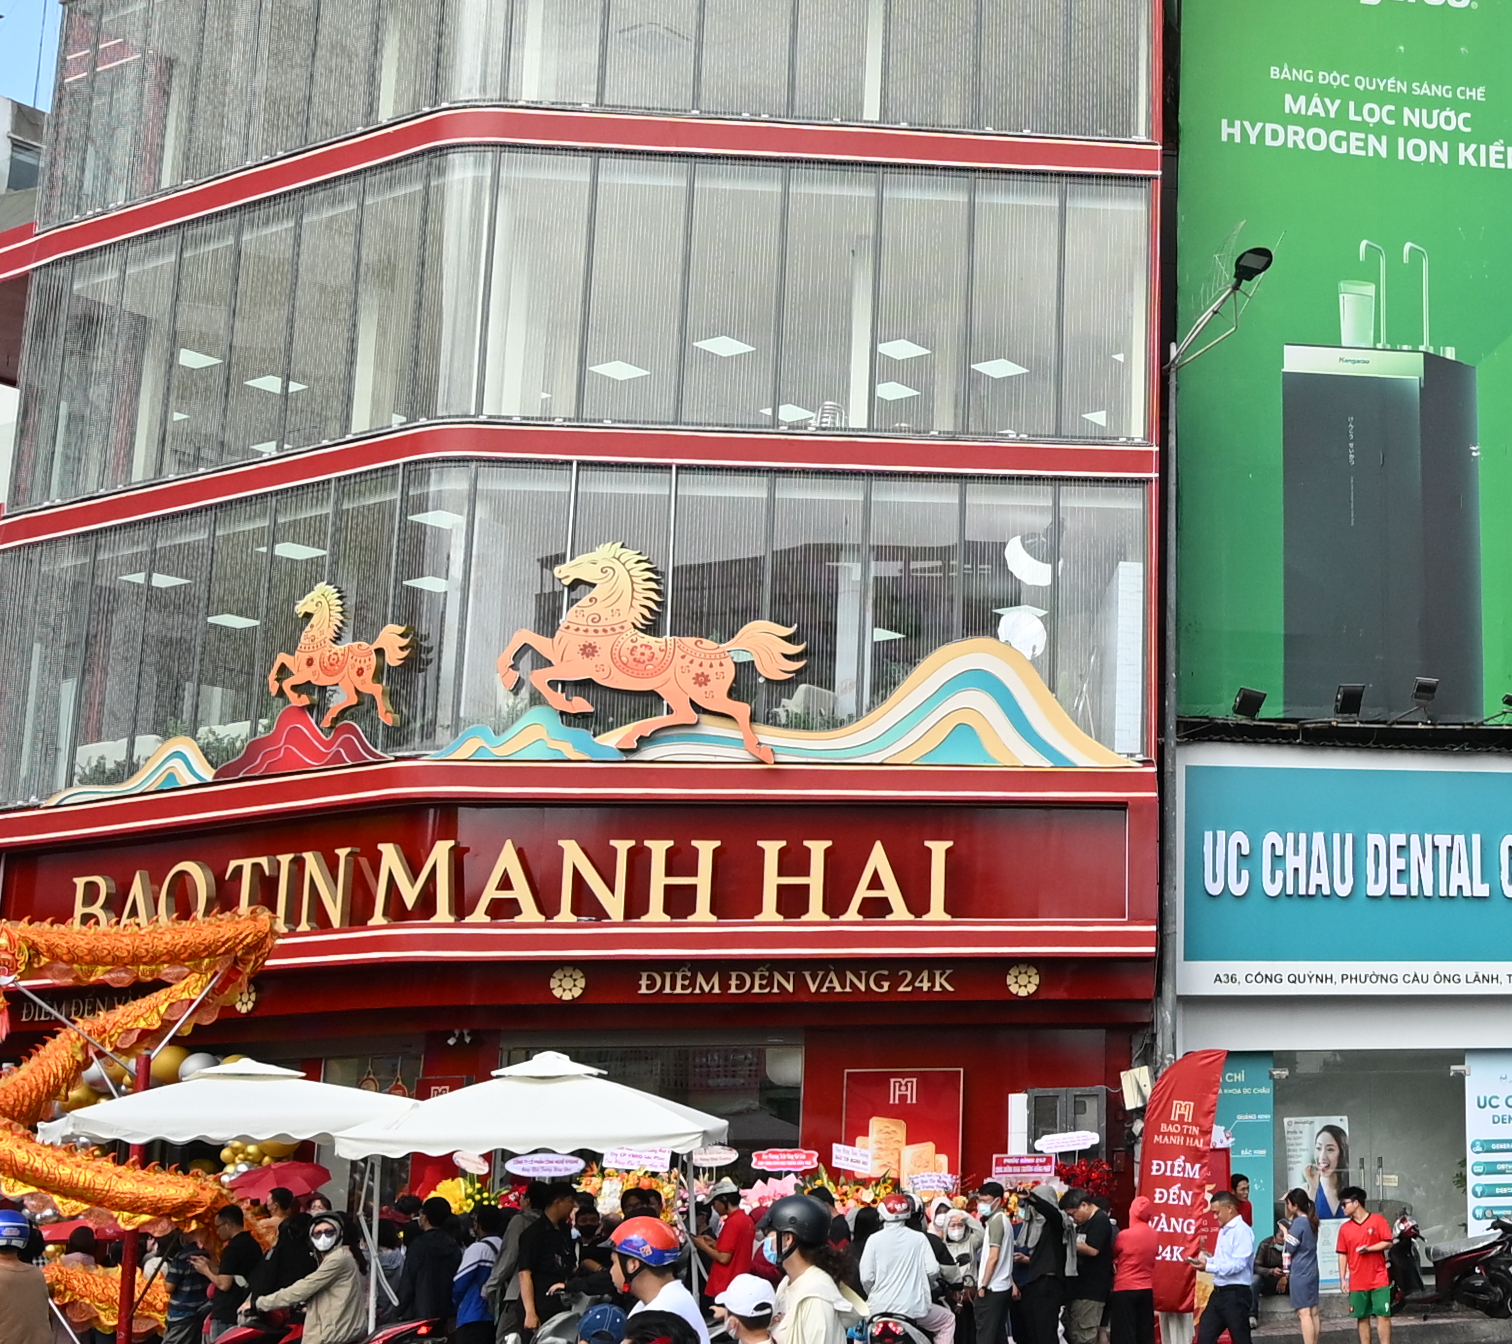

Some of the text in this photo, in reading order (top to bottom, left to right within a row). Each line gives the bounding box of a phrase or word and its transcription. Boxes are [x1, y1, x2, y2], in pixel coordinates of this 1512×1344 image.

[1317, 70, 1352, 90] ĐỘC
[1354, 71, 1407, 96] QUYỀN
[1410, 78, 1453, 100] SÁNG
[1456, 82, 1487, 103] CHẾ
[1283, 91, 1473, 134] MÁY LỌC NƯỚC
[1203, 829, 1250, 897] UC
[1262, 831, 1355, 898] CHAU
[1365, 831, 1491, 898] DENTAL
[72, 838, 954, 933] BAO TIN MANH HAI
[638, 964, 955, 995] ĐIỂM ĐẾN VÀNG 24K
[1213, 973, 1241, 987] A36,
[1288, 970, 1338, 986] QUỲNH,
[1341, 972, 1399, 984] PHƯỜNG
[1403, 971, 1430, 984] CẦU
[1434, 971, 1462, 984] ÔNG
[1465, 972, 1503, 986] LÃNH,
[1225, 1069, 1245, 1082] CHỈ
[1476, 1094, 1500, 1109] UC
[1153, 1134, 1204, 1147] MANH HAI
[1160, 1123, 1199, 1135] BAO TIN
[1151, 1155, 1201, 1179] ĐIỂM
[1154, 1183, 1193, 1206] ĐẾN
[1148, 1213, 1196, 1235] VÀNG
